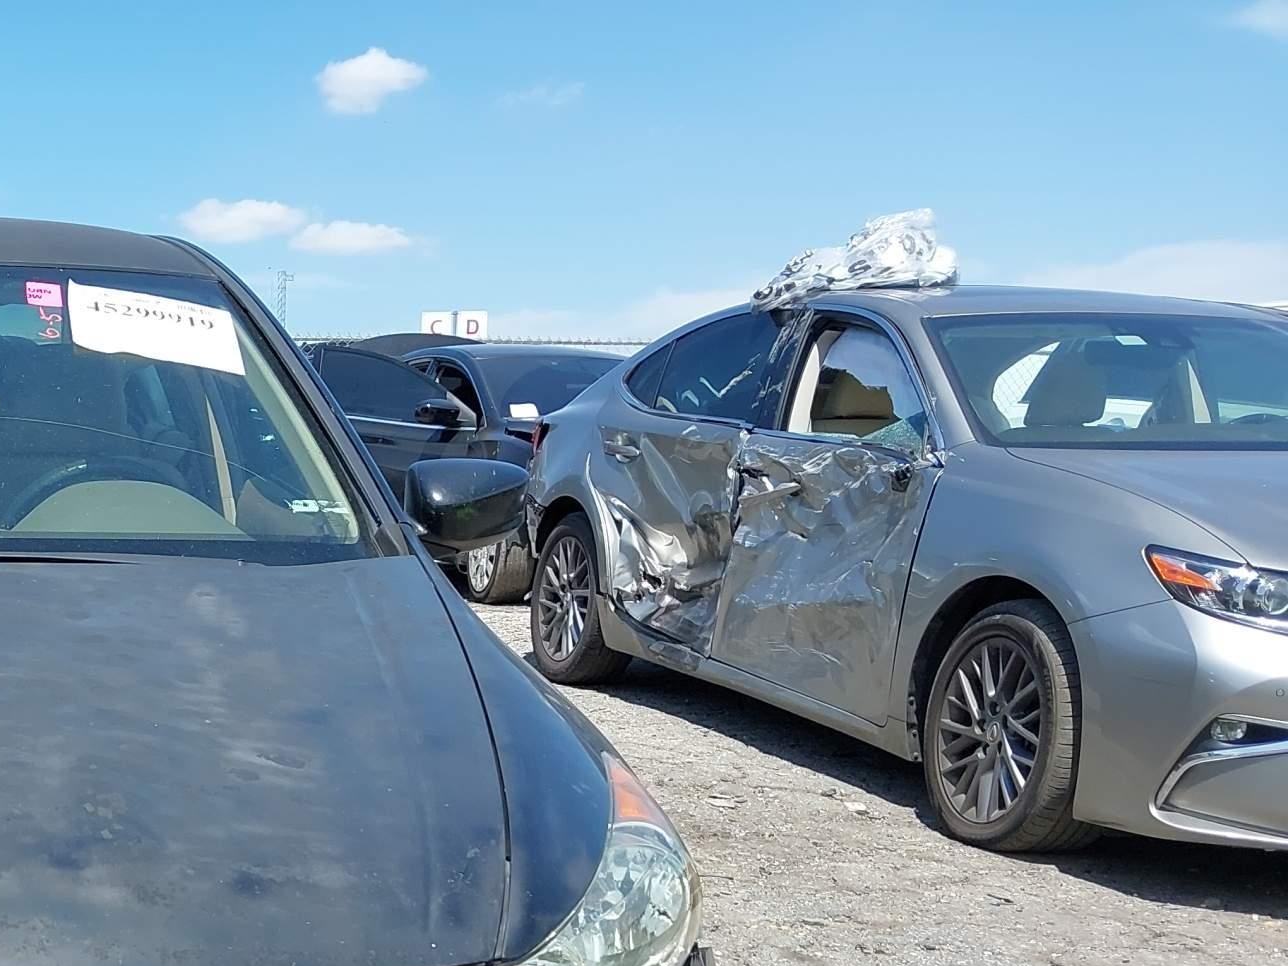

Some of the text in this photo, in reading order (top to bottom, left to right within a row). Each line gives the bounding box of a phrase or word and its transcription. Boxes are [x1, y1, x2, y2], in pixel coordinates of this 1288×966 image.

[85, 300, 216, 331] 45299919
[430, 319, 443, 334] C
[466, 319, 480, 335] D
